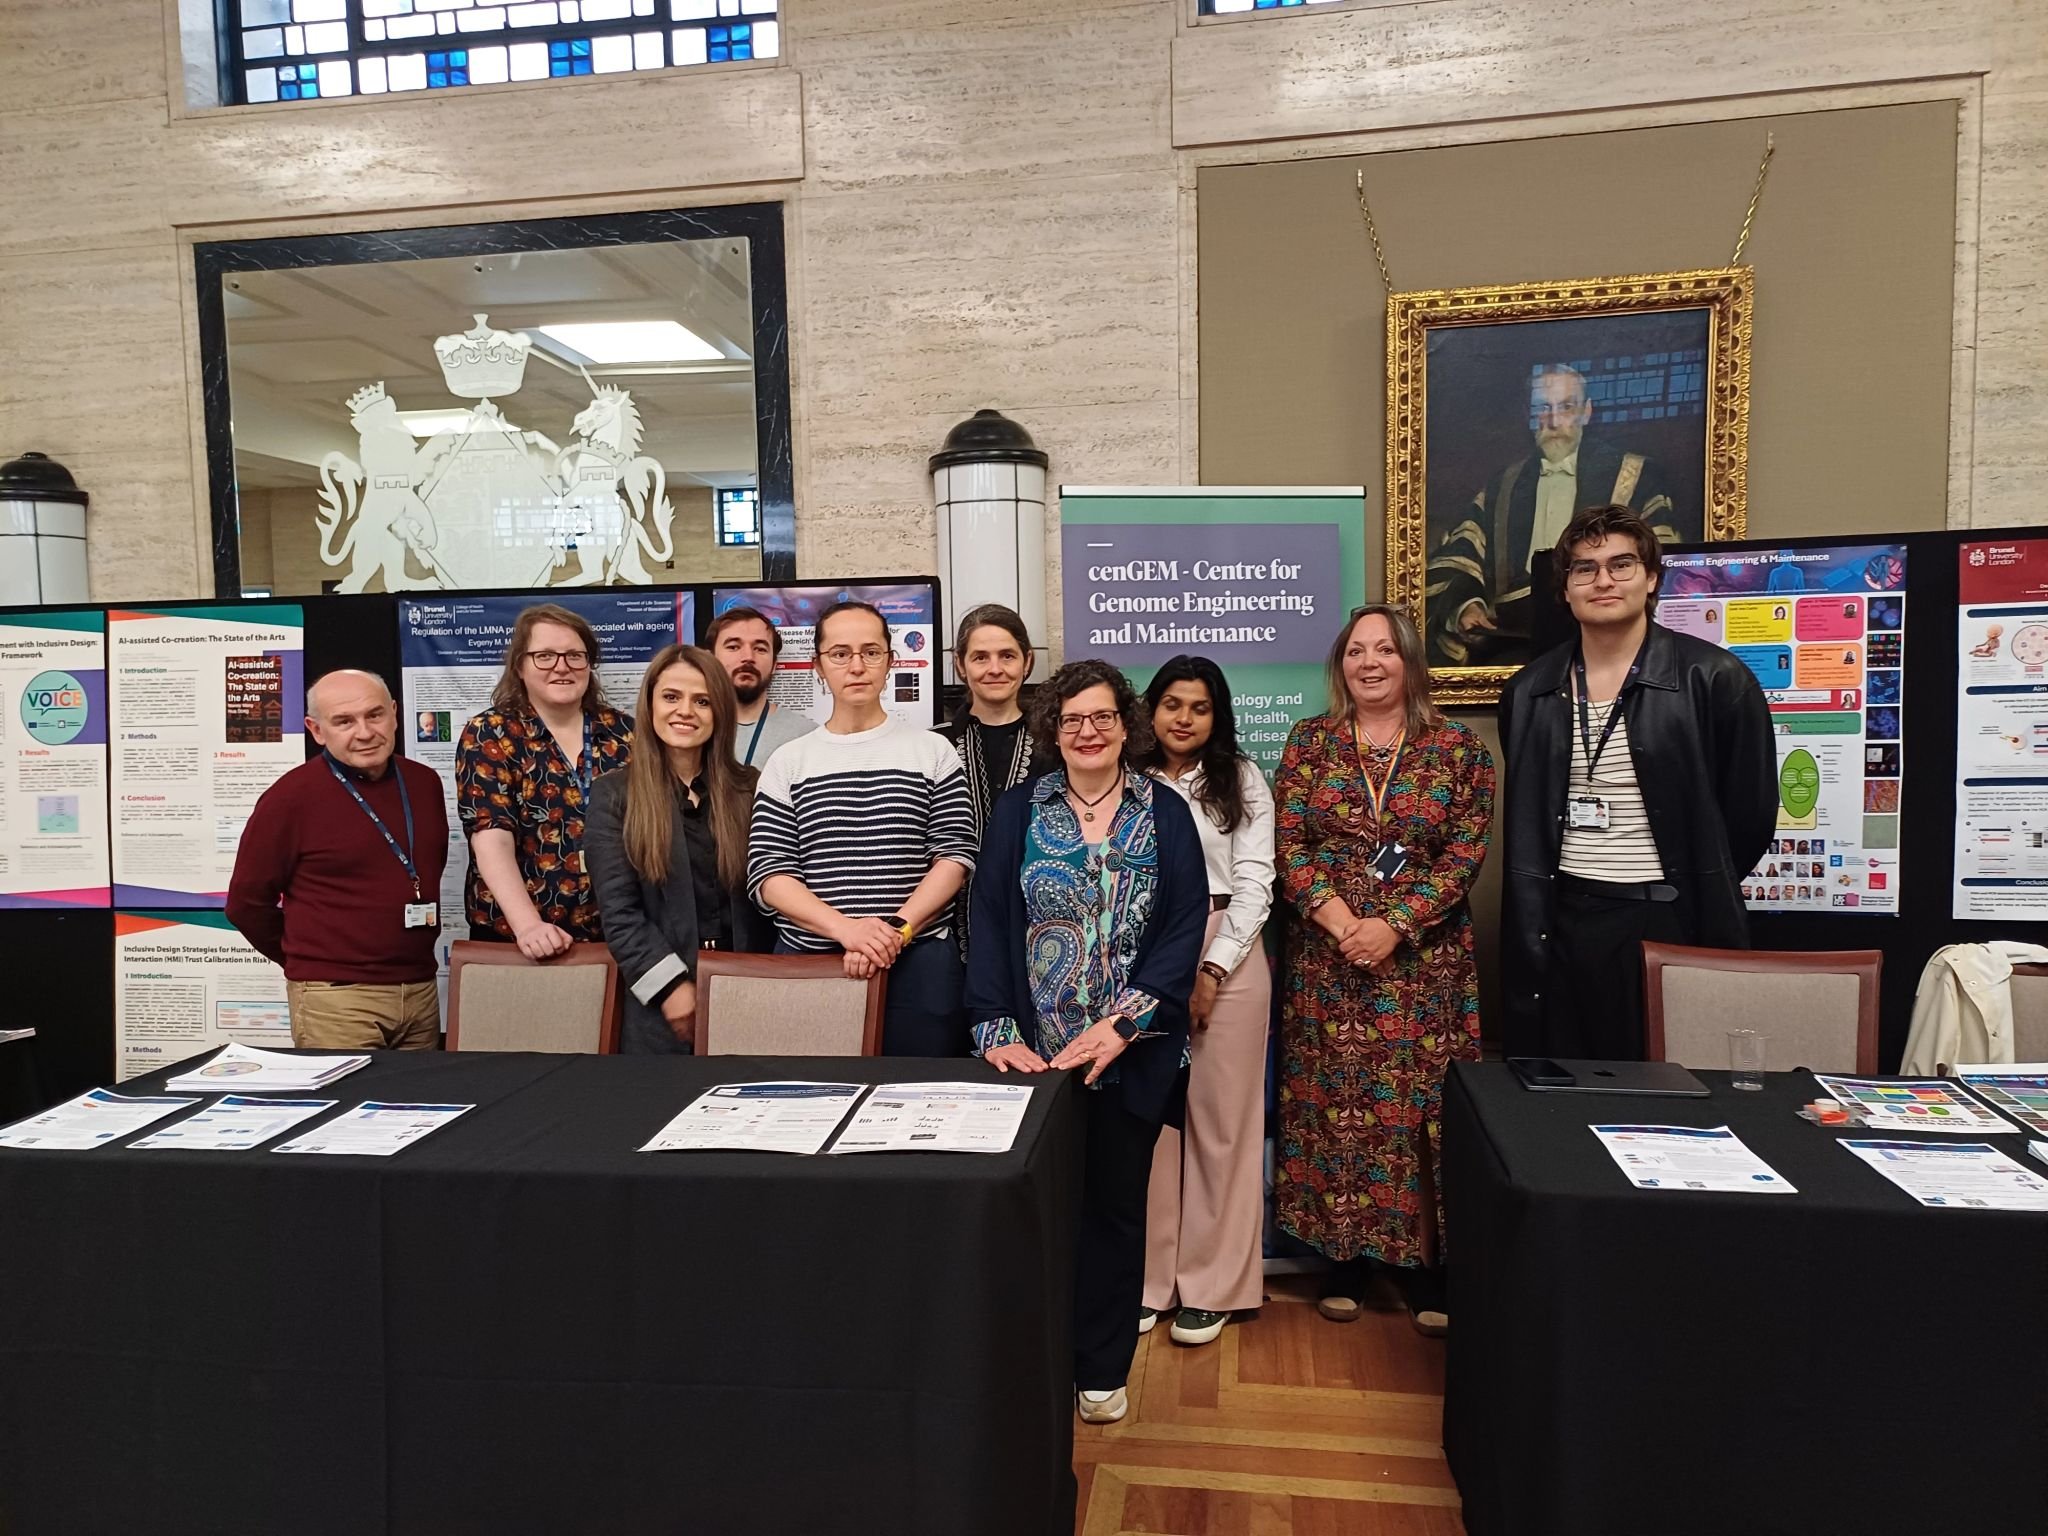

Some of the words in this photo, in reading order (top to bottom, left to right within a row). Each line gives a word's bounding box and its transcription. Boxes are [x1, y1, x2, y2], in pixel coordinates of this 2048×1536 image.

[1666, 559, 1704, 567] Genome
[1706, 556, 1758, 566] Engineering
[1770, 554, 1829, 563] Maintenance
[1088, 560, 1179, 582] cenGEM
[1193, 560, 1266, 580] Centre
[1270, 559, 1301, 579] for
[1089, 592, 1179, 613] Genome
[1183, 590, 1314, 617] Engineering
[411, 627, 453, 637] Regulation
[479, 626, 504, 634] LMNA
[627, 622, 643, 630] with
[646, 622, 674, 632] ageing
[1089, 623, 1131, 645] and
[1136, 622, 1276, 644] Maintenance
[468, 638, 493, 647] Evgeny
[228, 661, 274, 669] AI-assisted
[228, 672, 279, 680] Co-creation:
[27, 691, 82, 707] VOICE
[1276, 693, 1302, 705] and
[1245, 712, 1293, 725] health,
[182, 946, 218, 954] Strategies
